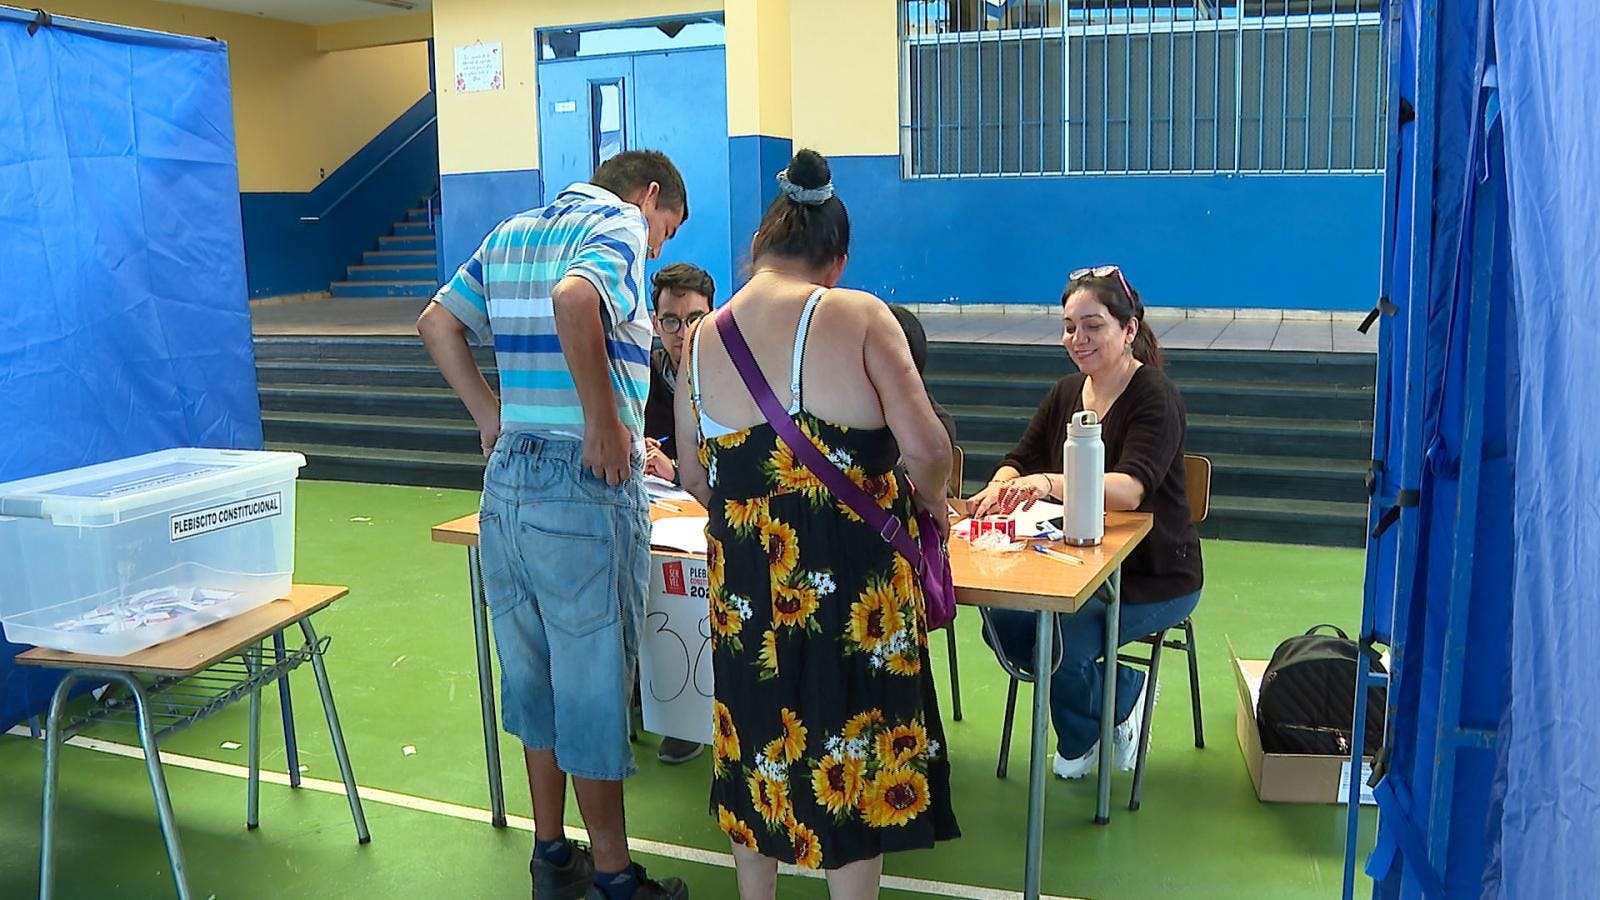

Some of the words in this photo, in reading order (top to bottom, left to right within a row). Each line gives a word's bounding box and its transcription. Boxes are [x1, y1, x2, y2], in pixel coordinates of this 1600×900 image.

[174, 513, 217, 534] PLEBISCITO
[218, 498, 279, 523] CONSTITUCIONAL
[689, 567, 707, 579] PLEB
